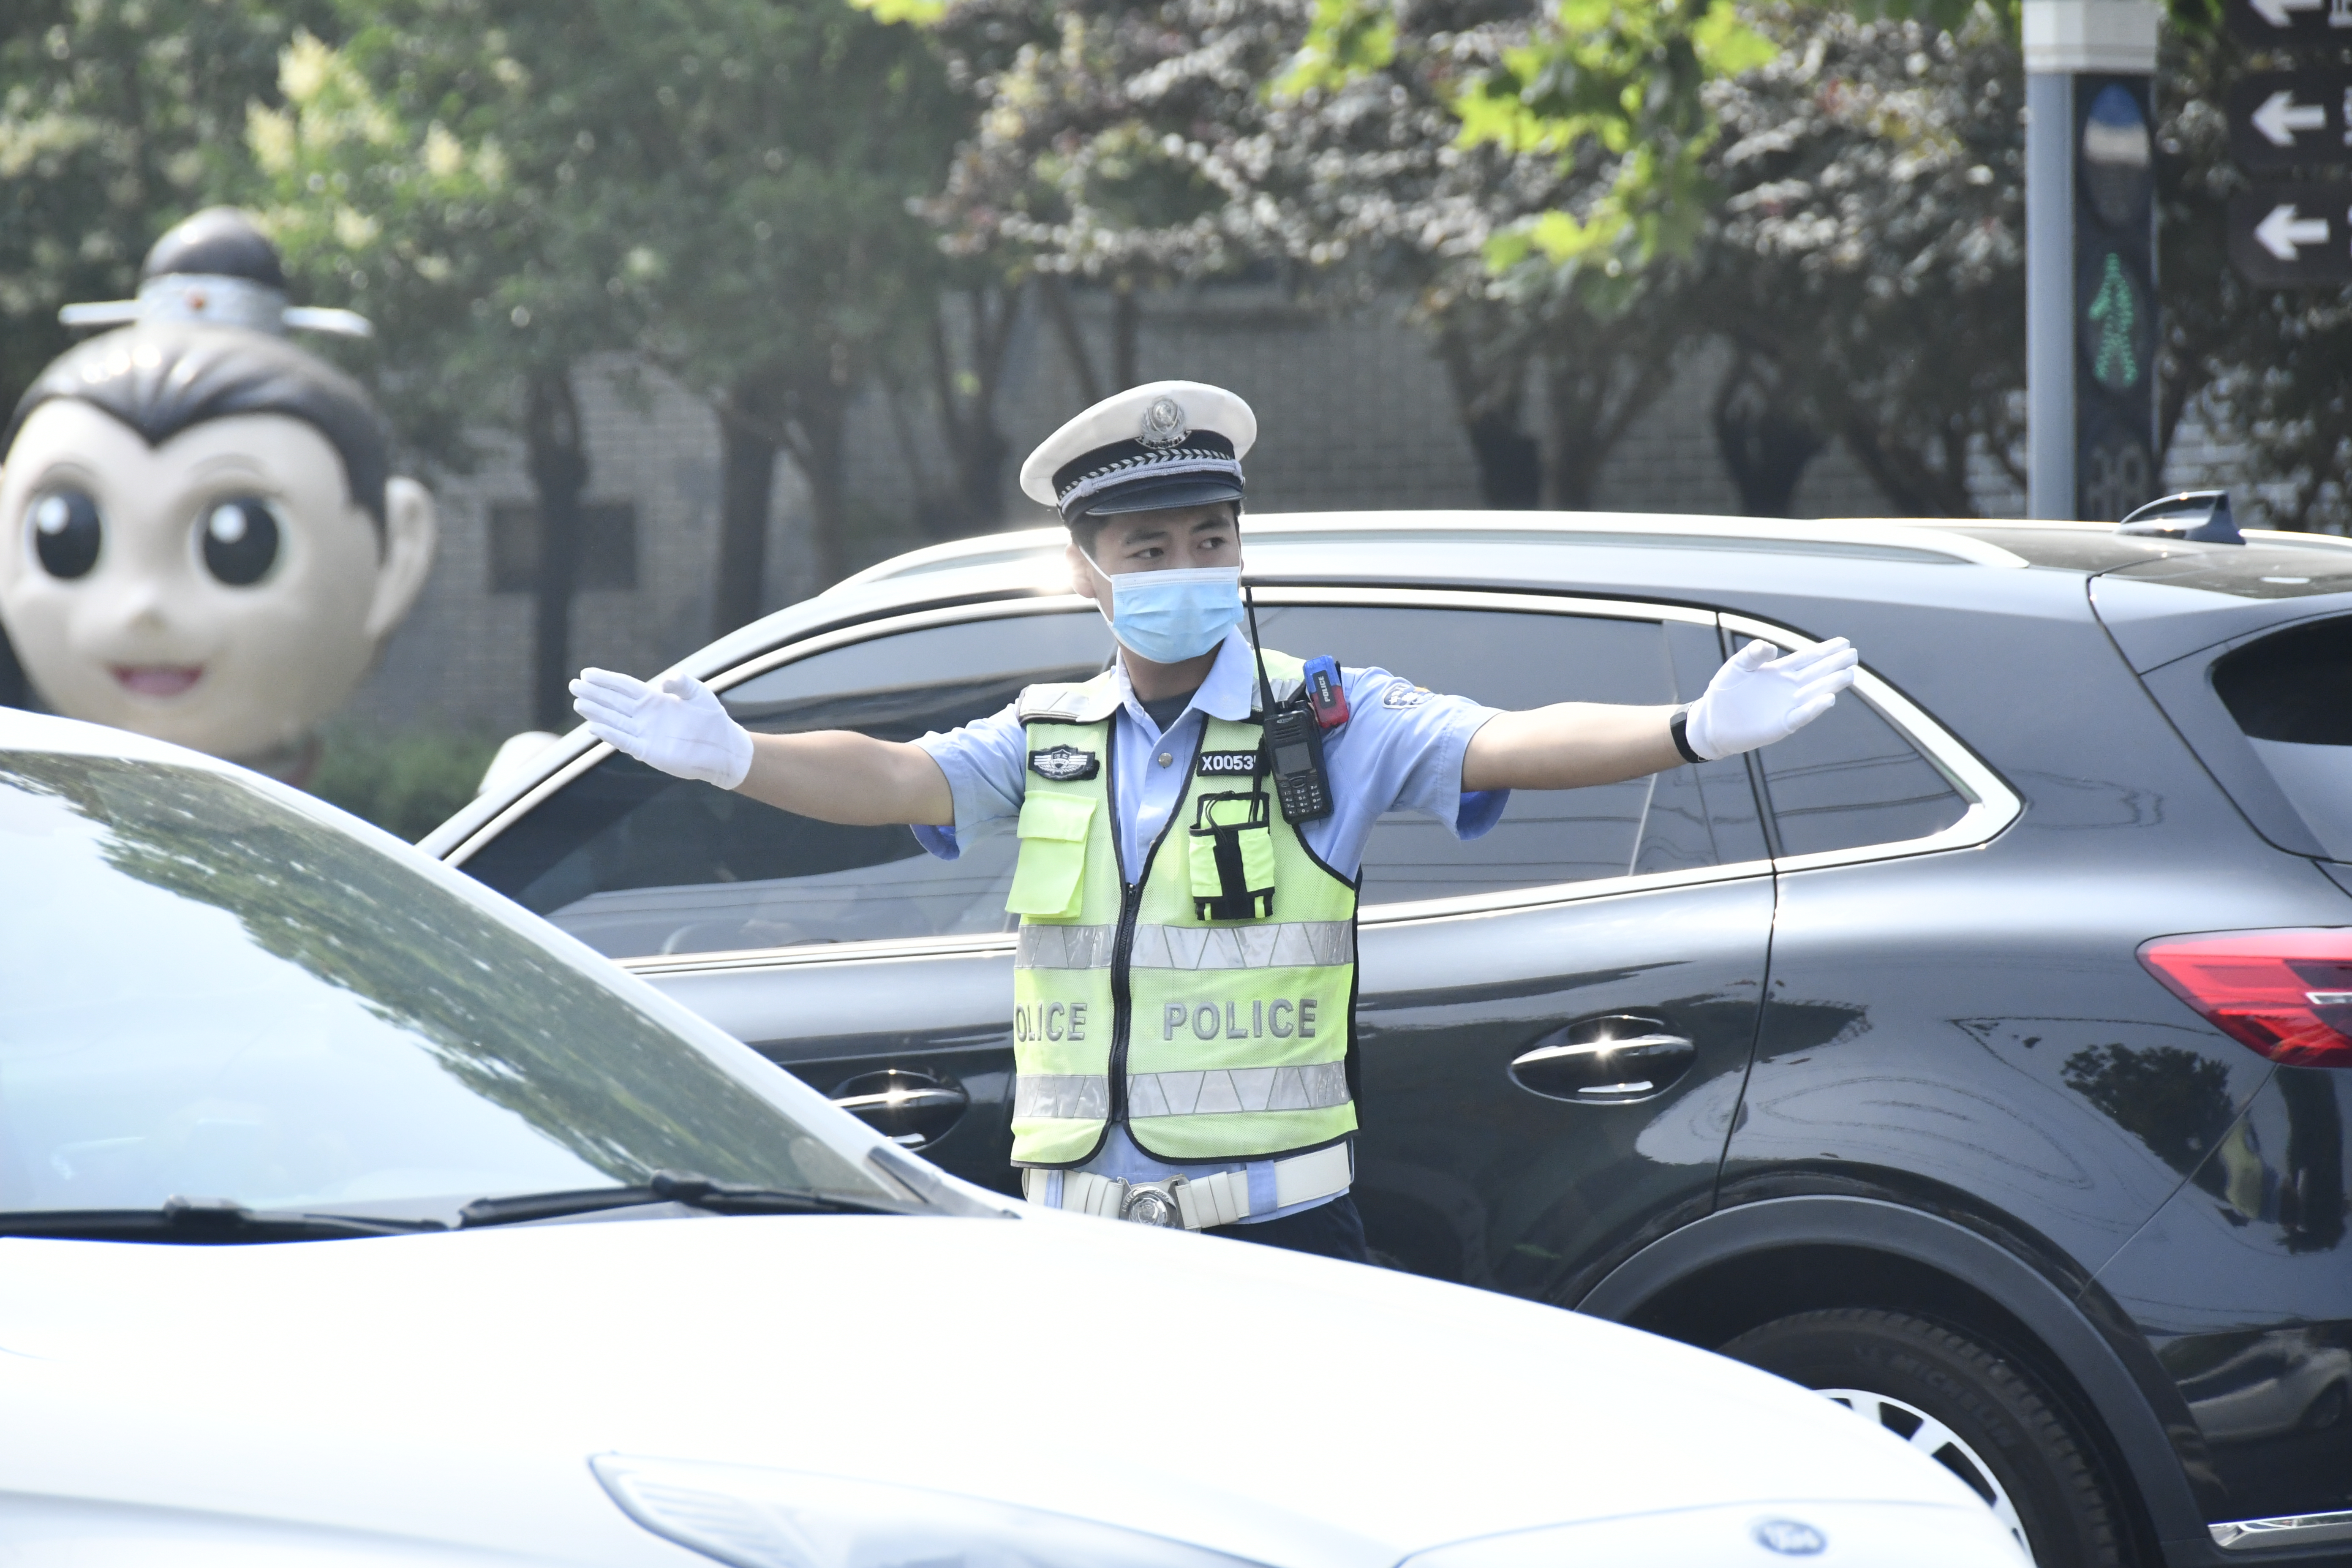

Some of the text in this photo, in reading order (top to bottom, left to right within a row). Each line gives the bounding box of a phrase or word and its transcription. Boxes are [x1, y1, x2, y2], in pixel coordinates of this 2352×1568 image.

[1318, 675, 1331, 702] POLICE
[1202, 755, 1256, 771] X0053
[1016, 1002, 1087, 1042] OLICE
[1164, 998, 1318, 1041] POLICE
